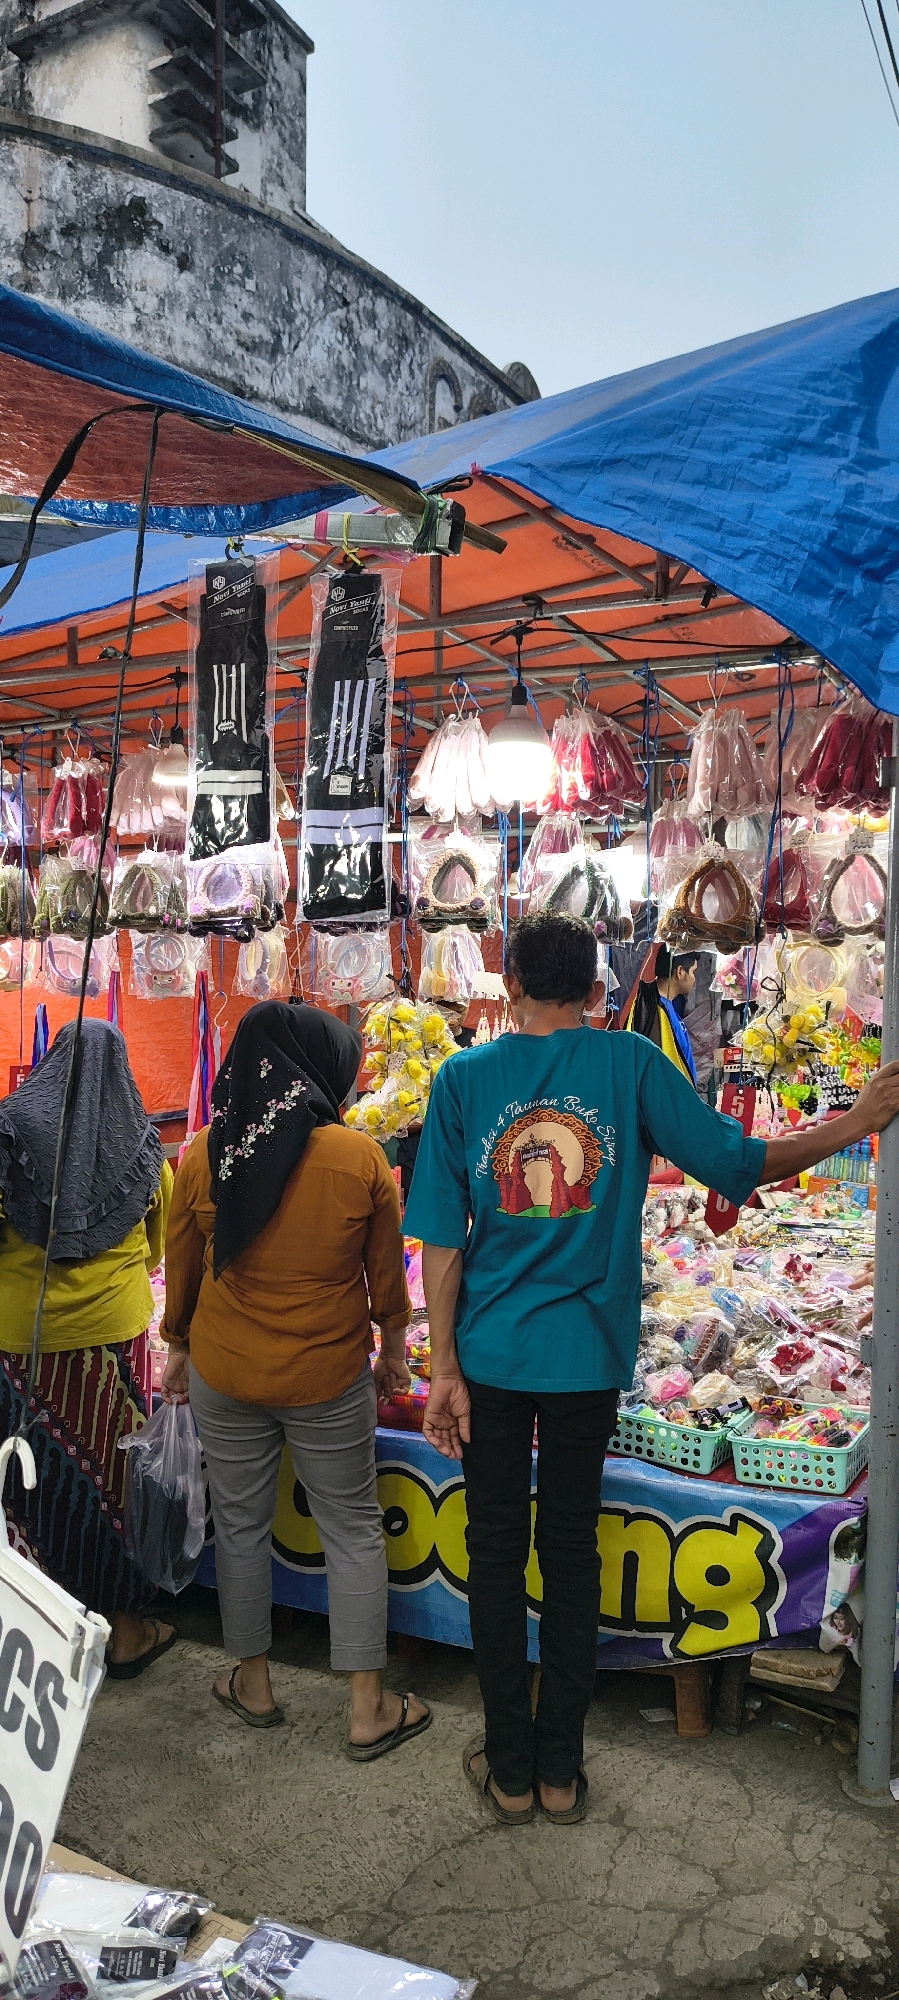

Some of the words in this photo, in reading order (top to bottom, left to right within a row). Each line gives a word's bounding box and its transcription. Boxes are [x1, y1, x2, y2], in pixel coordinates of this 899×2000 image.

[213, 588, 230, 604] Novi
[231, 577, 252, 592] Yanti
[329, 602, 347, 615] Novi
[349, 596, 372, 608] Yanti
[730, 1095, 745, 1118] 5
[497, 1113, 506, 1127] 4
[0, 1614, 69, 1772] CS
